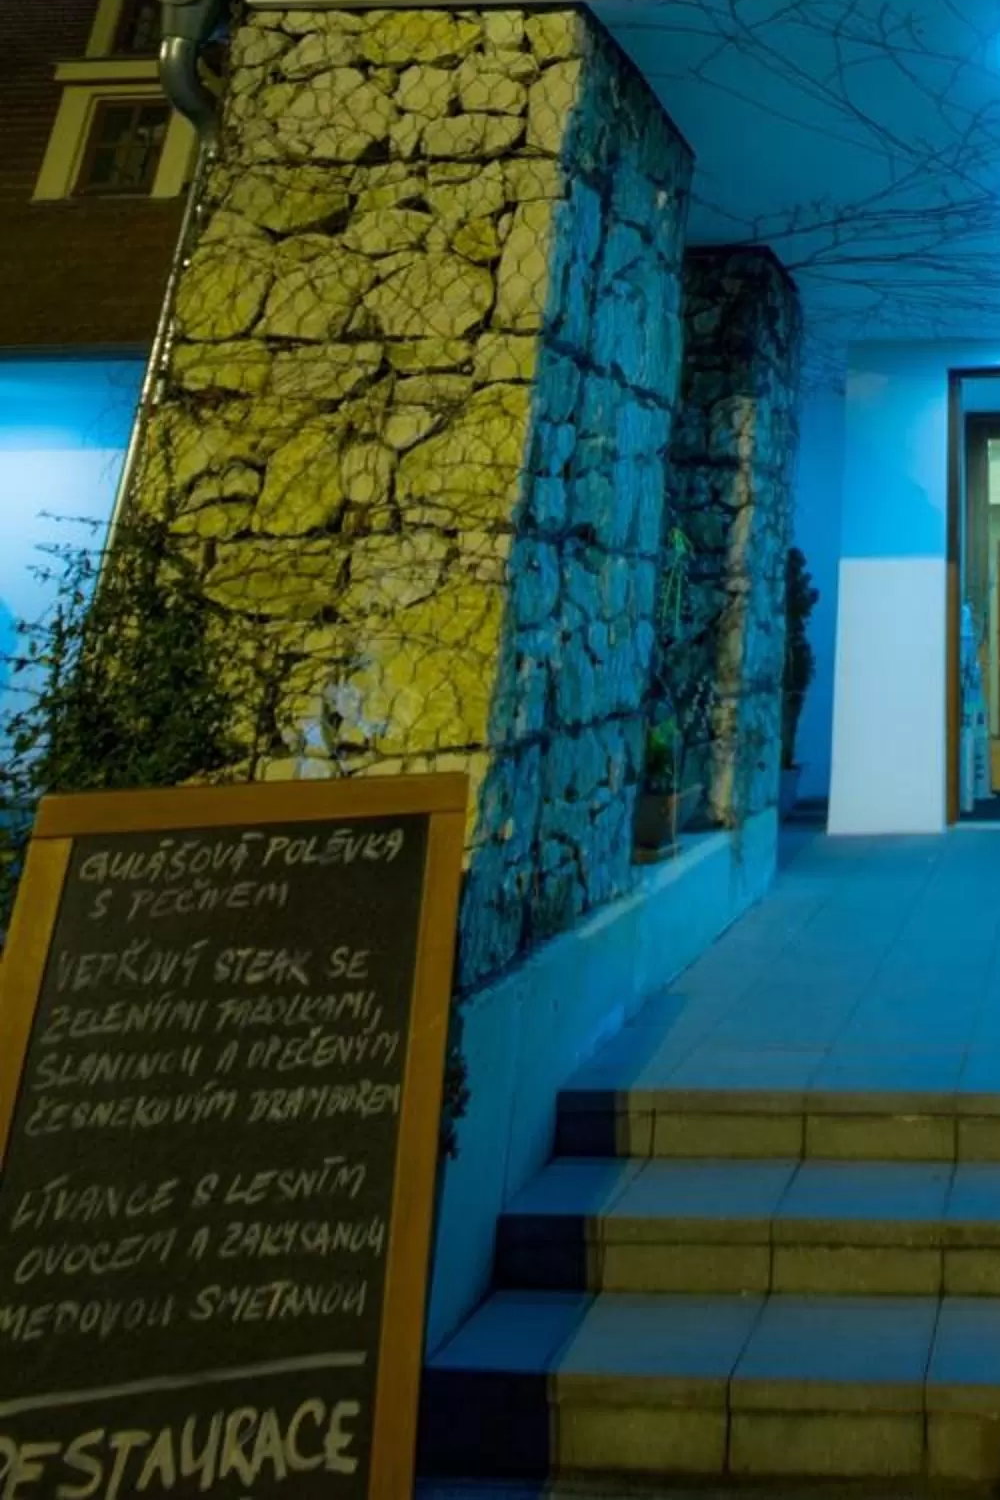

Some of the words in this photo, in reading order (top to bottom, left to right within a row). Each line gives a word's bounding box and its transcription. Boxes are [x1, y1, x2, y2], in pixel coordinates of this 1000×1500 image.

[88, 888, 113, 920] S
[213, 947, 311, 986] STEAK
[328, 945, 370, 979] SE
[214, 1047, 238, 1074] A
[14, 1228, 177, 1284] OVOCEM
[187, 1226, 207, 1257] A
[189, 1279, 368, 1322] SMETANOU
